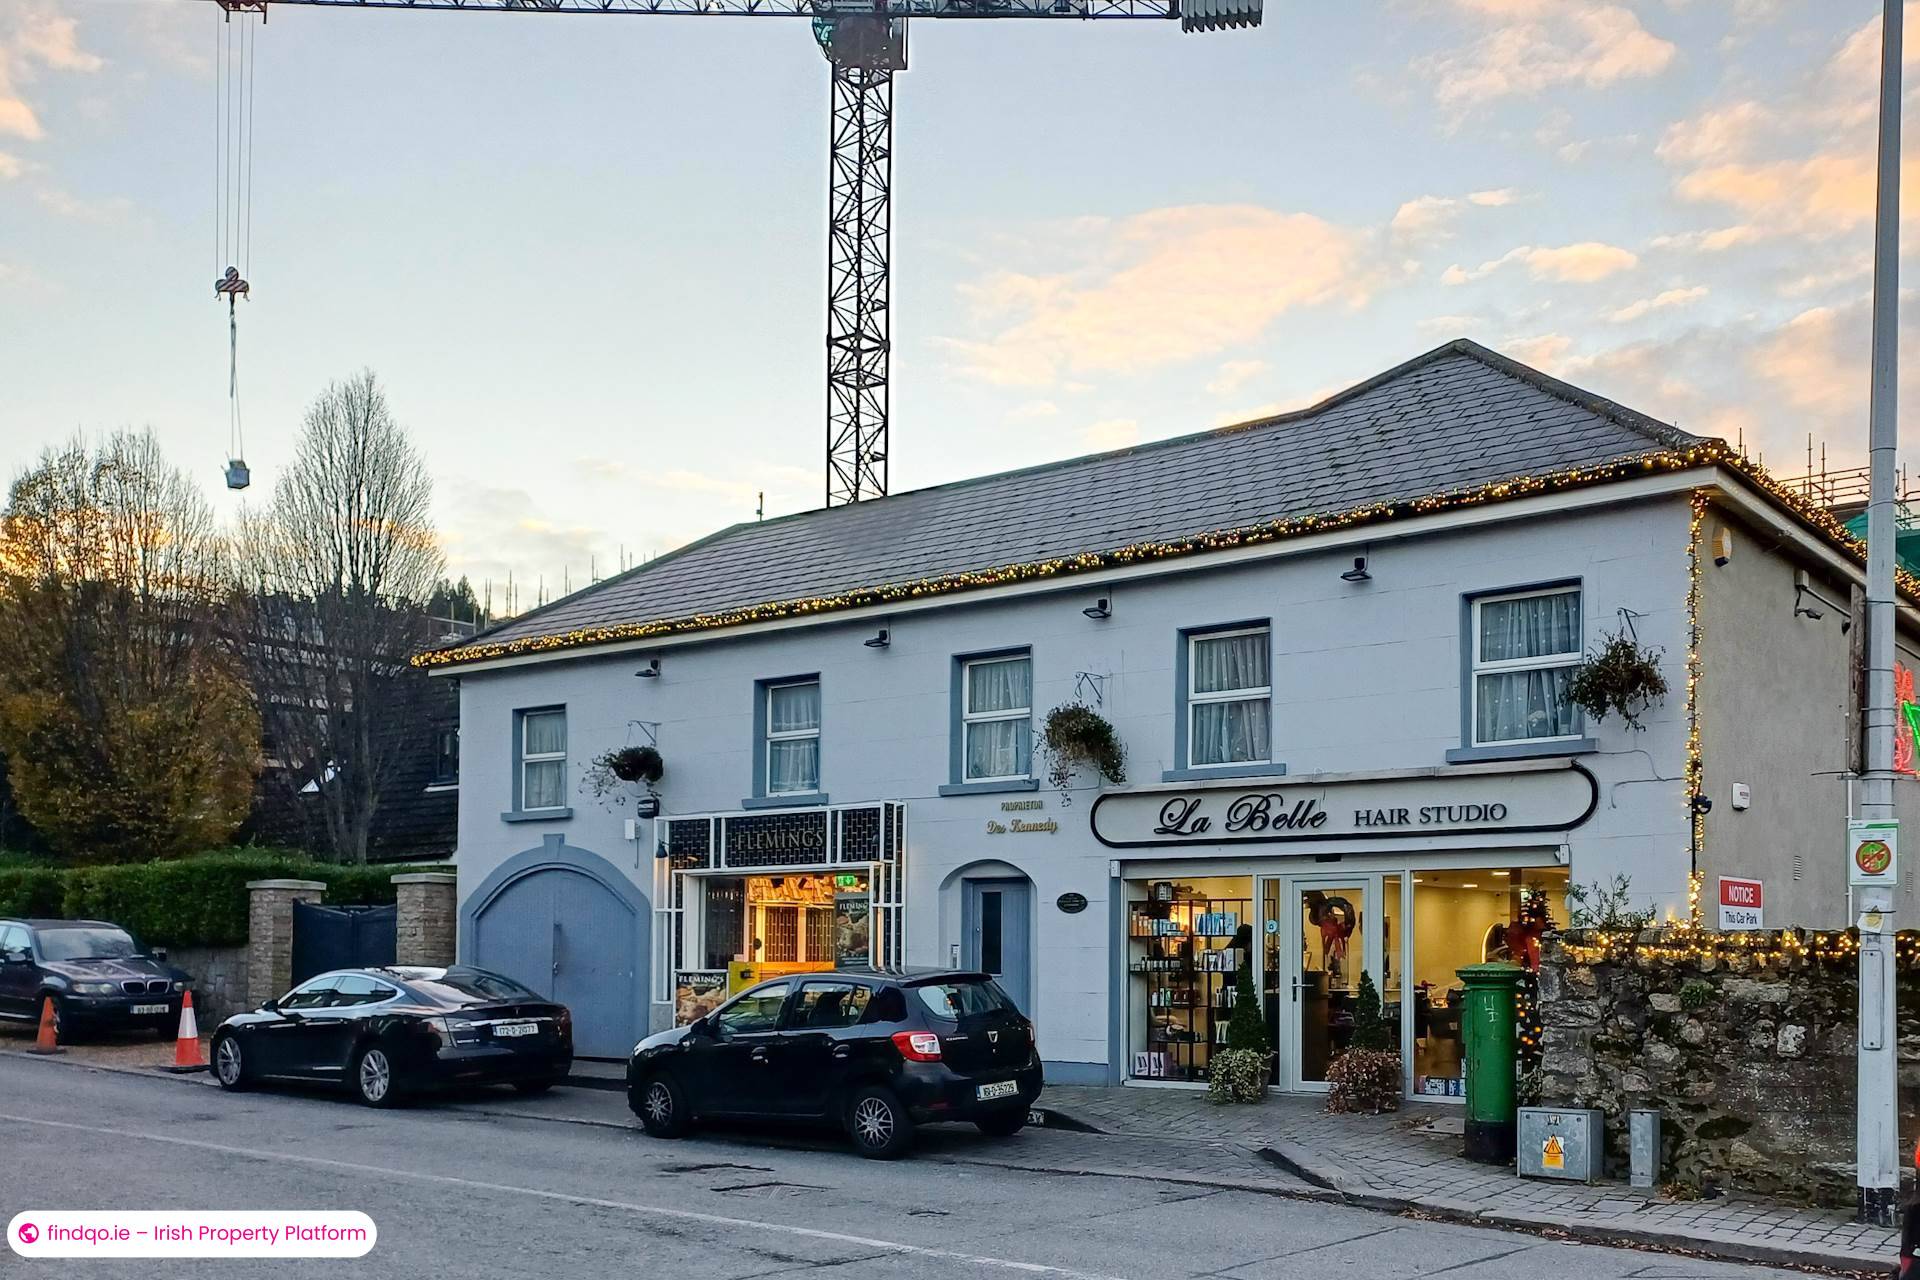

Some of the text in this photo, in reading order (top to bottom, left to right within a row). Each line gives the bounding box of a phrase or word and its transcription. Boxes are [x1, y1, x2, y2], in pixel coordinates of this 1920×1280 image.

[1154, 793, 1507, 836] La Belle HAIR STUDIO
[986, 817, 1058, 834] Des Kennedy
[737, 830, 824, 850] FLEMINGS
[1728, 885, 1754, 904] NOTICE
[1725, 911, 1758, 925] This Car Park
